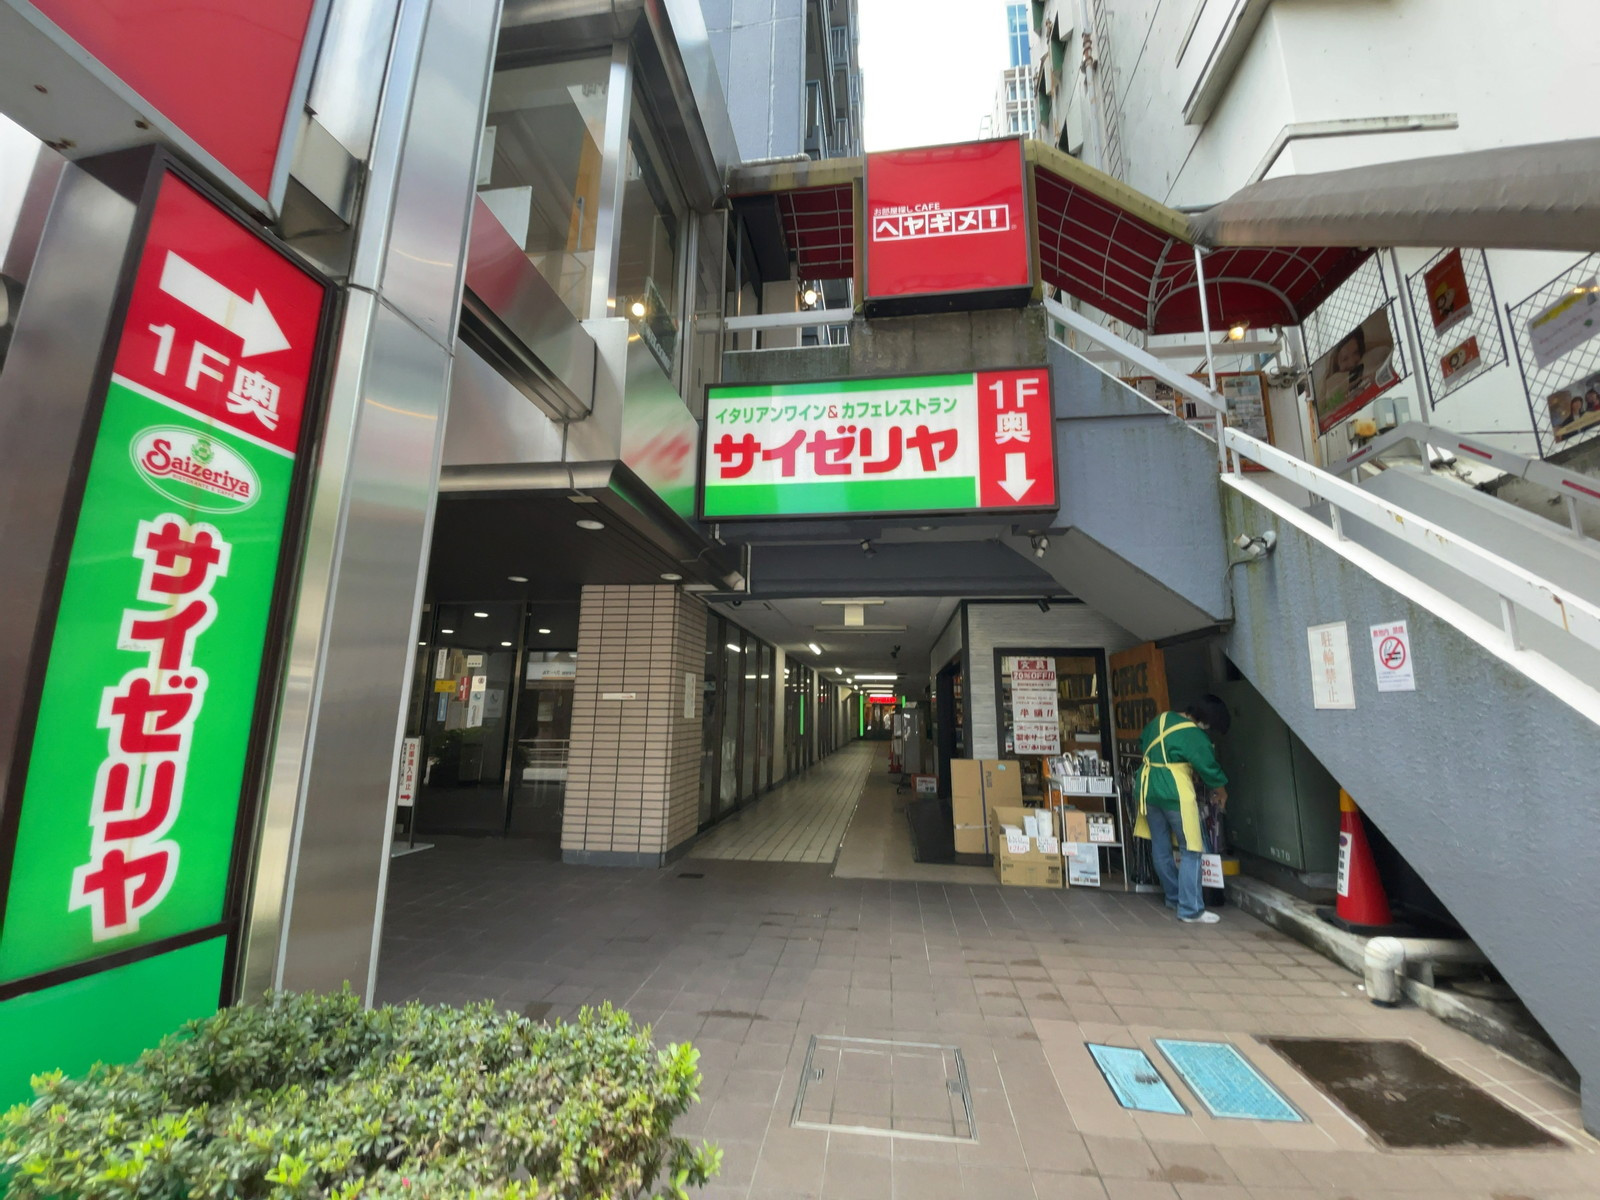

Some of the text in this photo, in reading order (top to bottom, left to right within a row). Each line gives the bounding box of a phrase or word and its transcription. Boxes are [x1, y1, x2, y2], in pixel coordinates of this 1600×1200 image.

[914, 201, 940, 212] CAFE
[713, 424, 959, 479] サイゼリヤ
[994, 410, 1031, 446] 奥
[141, 438, 250, 497] Saizeriya
[77, 518, 226, 934] サイゼリヤ
